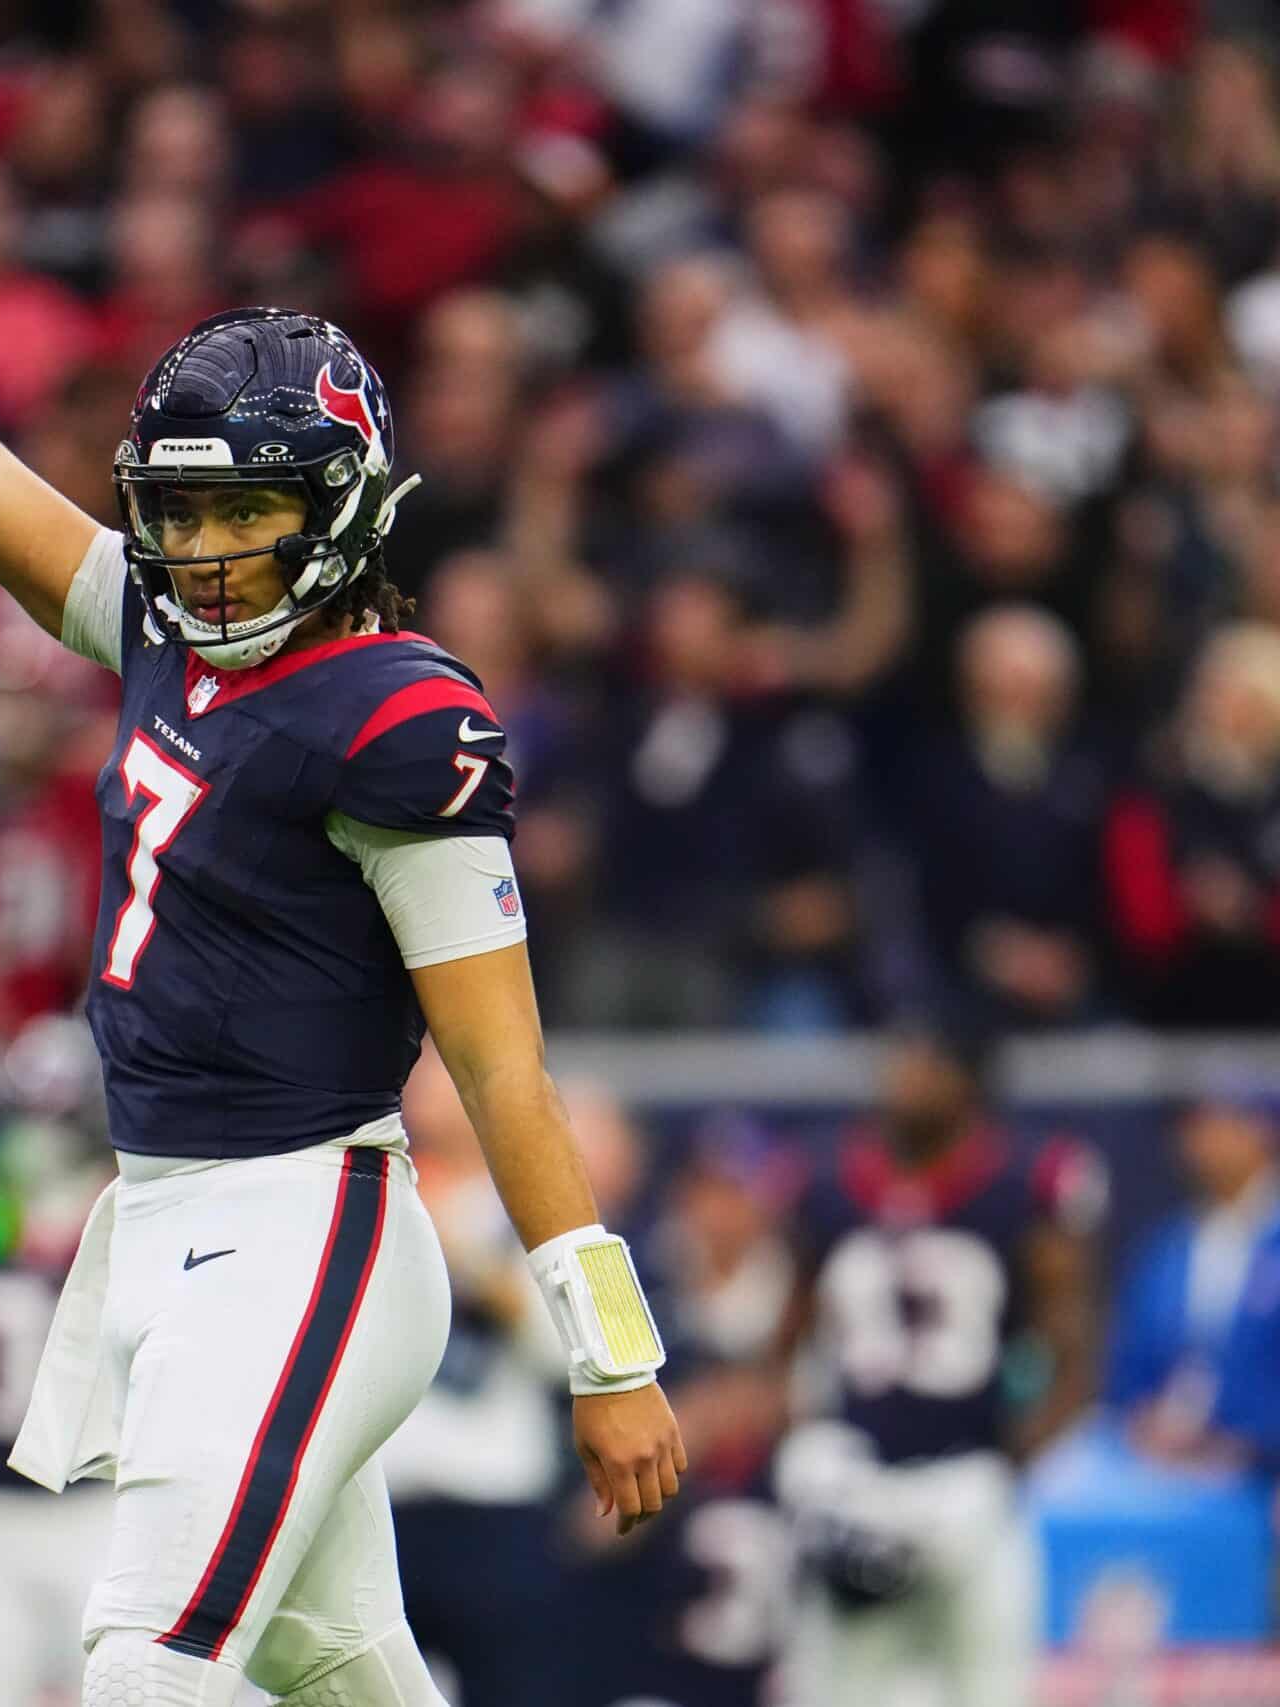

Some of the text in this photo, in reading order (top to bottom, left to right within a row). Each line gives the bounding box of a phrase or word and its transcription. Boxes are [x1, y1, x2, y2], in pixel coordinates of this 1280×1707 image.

[154, 715, 201, 761] TEXANS
[438, 751, 488, 816] 7
[102, 729, 210, 990] 7
